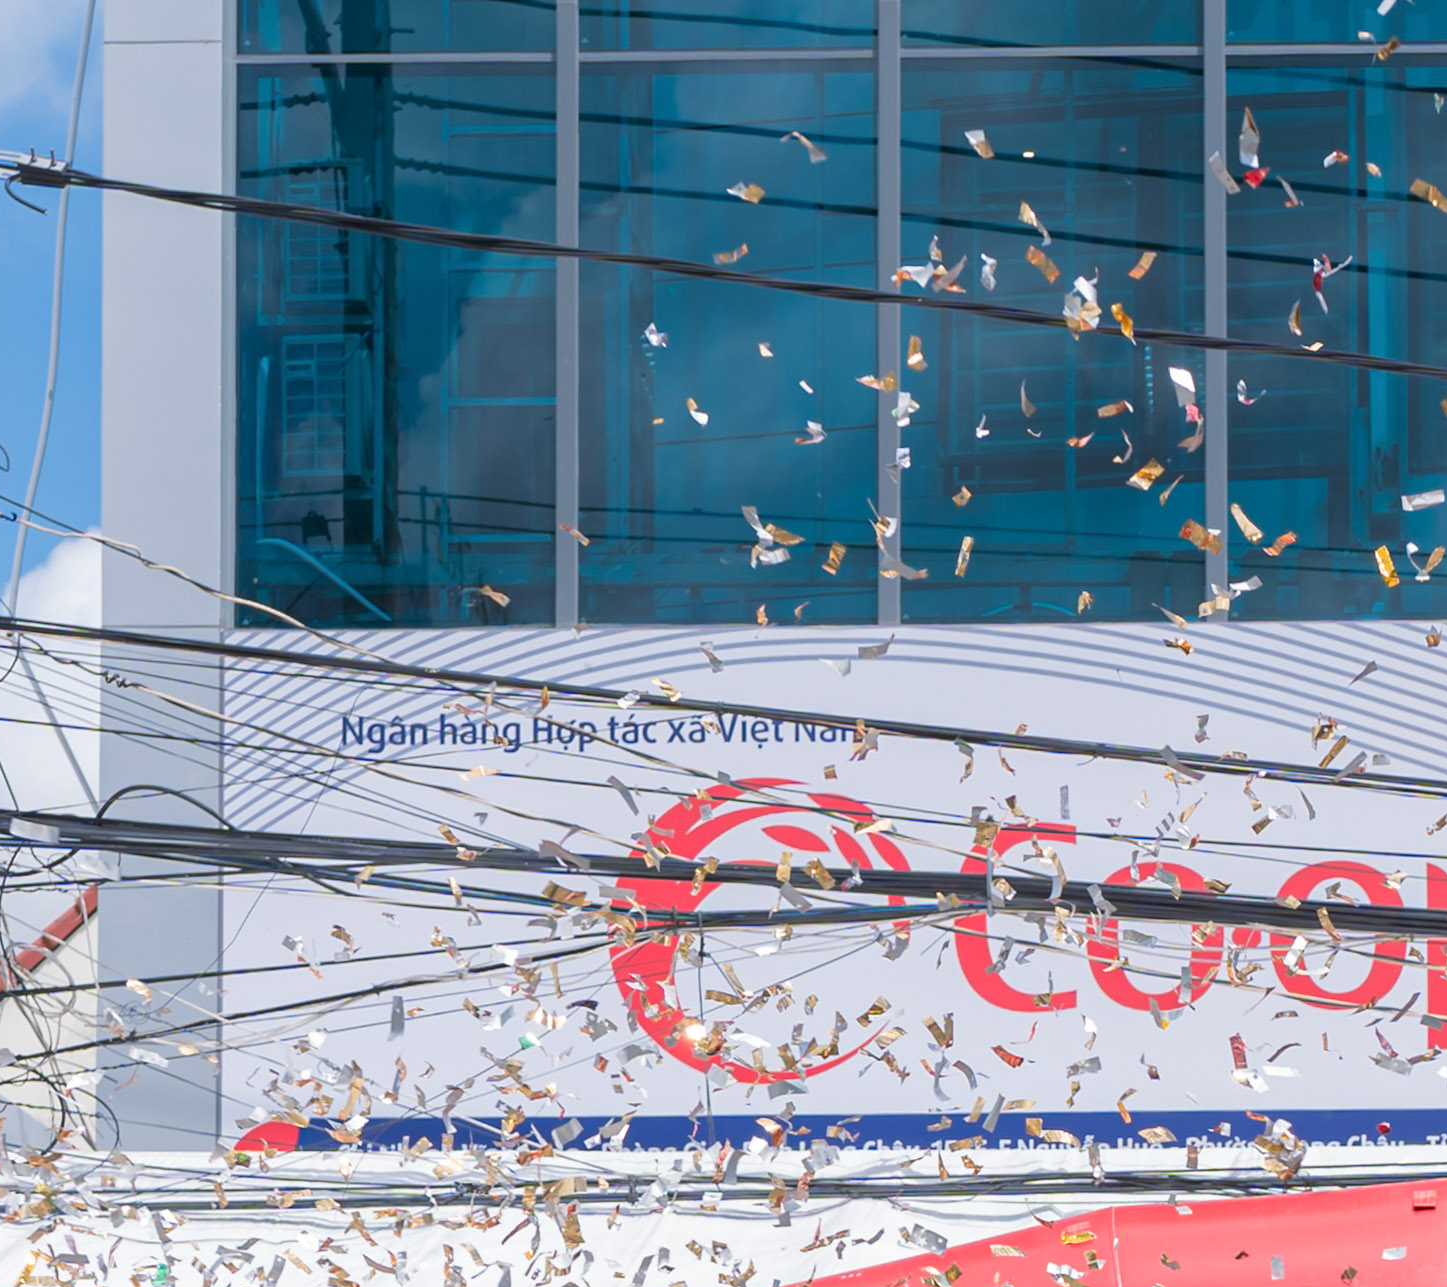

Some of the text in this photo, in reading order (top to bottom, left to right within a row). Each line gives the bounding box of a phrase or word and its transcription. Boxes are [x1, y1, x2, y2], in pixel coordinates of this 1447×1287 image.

[341, 716, 435, 753] Ngân
[440, 713, 521, 753] hàng
[533, 716, 597, 752] Hợp
[608, 713, 657, 744] tác
[667, 714, 706, 743] xã
[794, 721, 862, 744] Na
